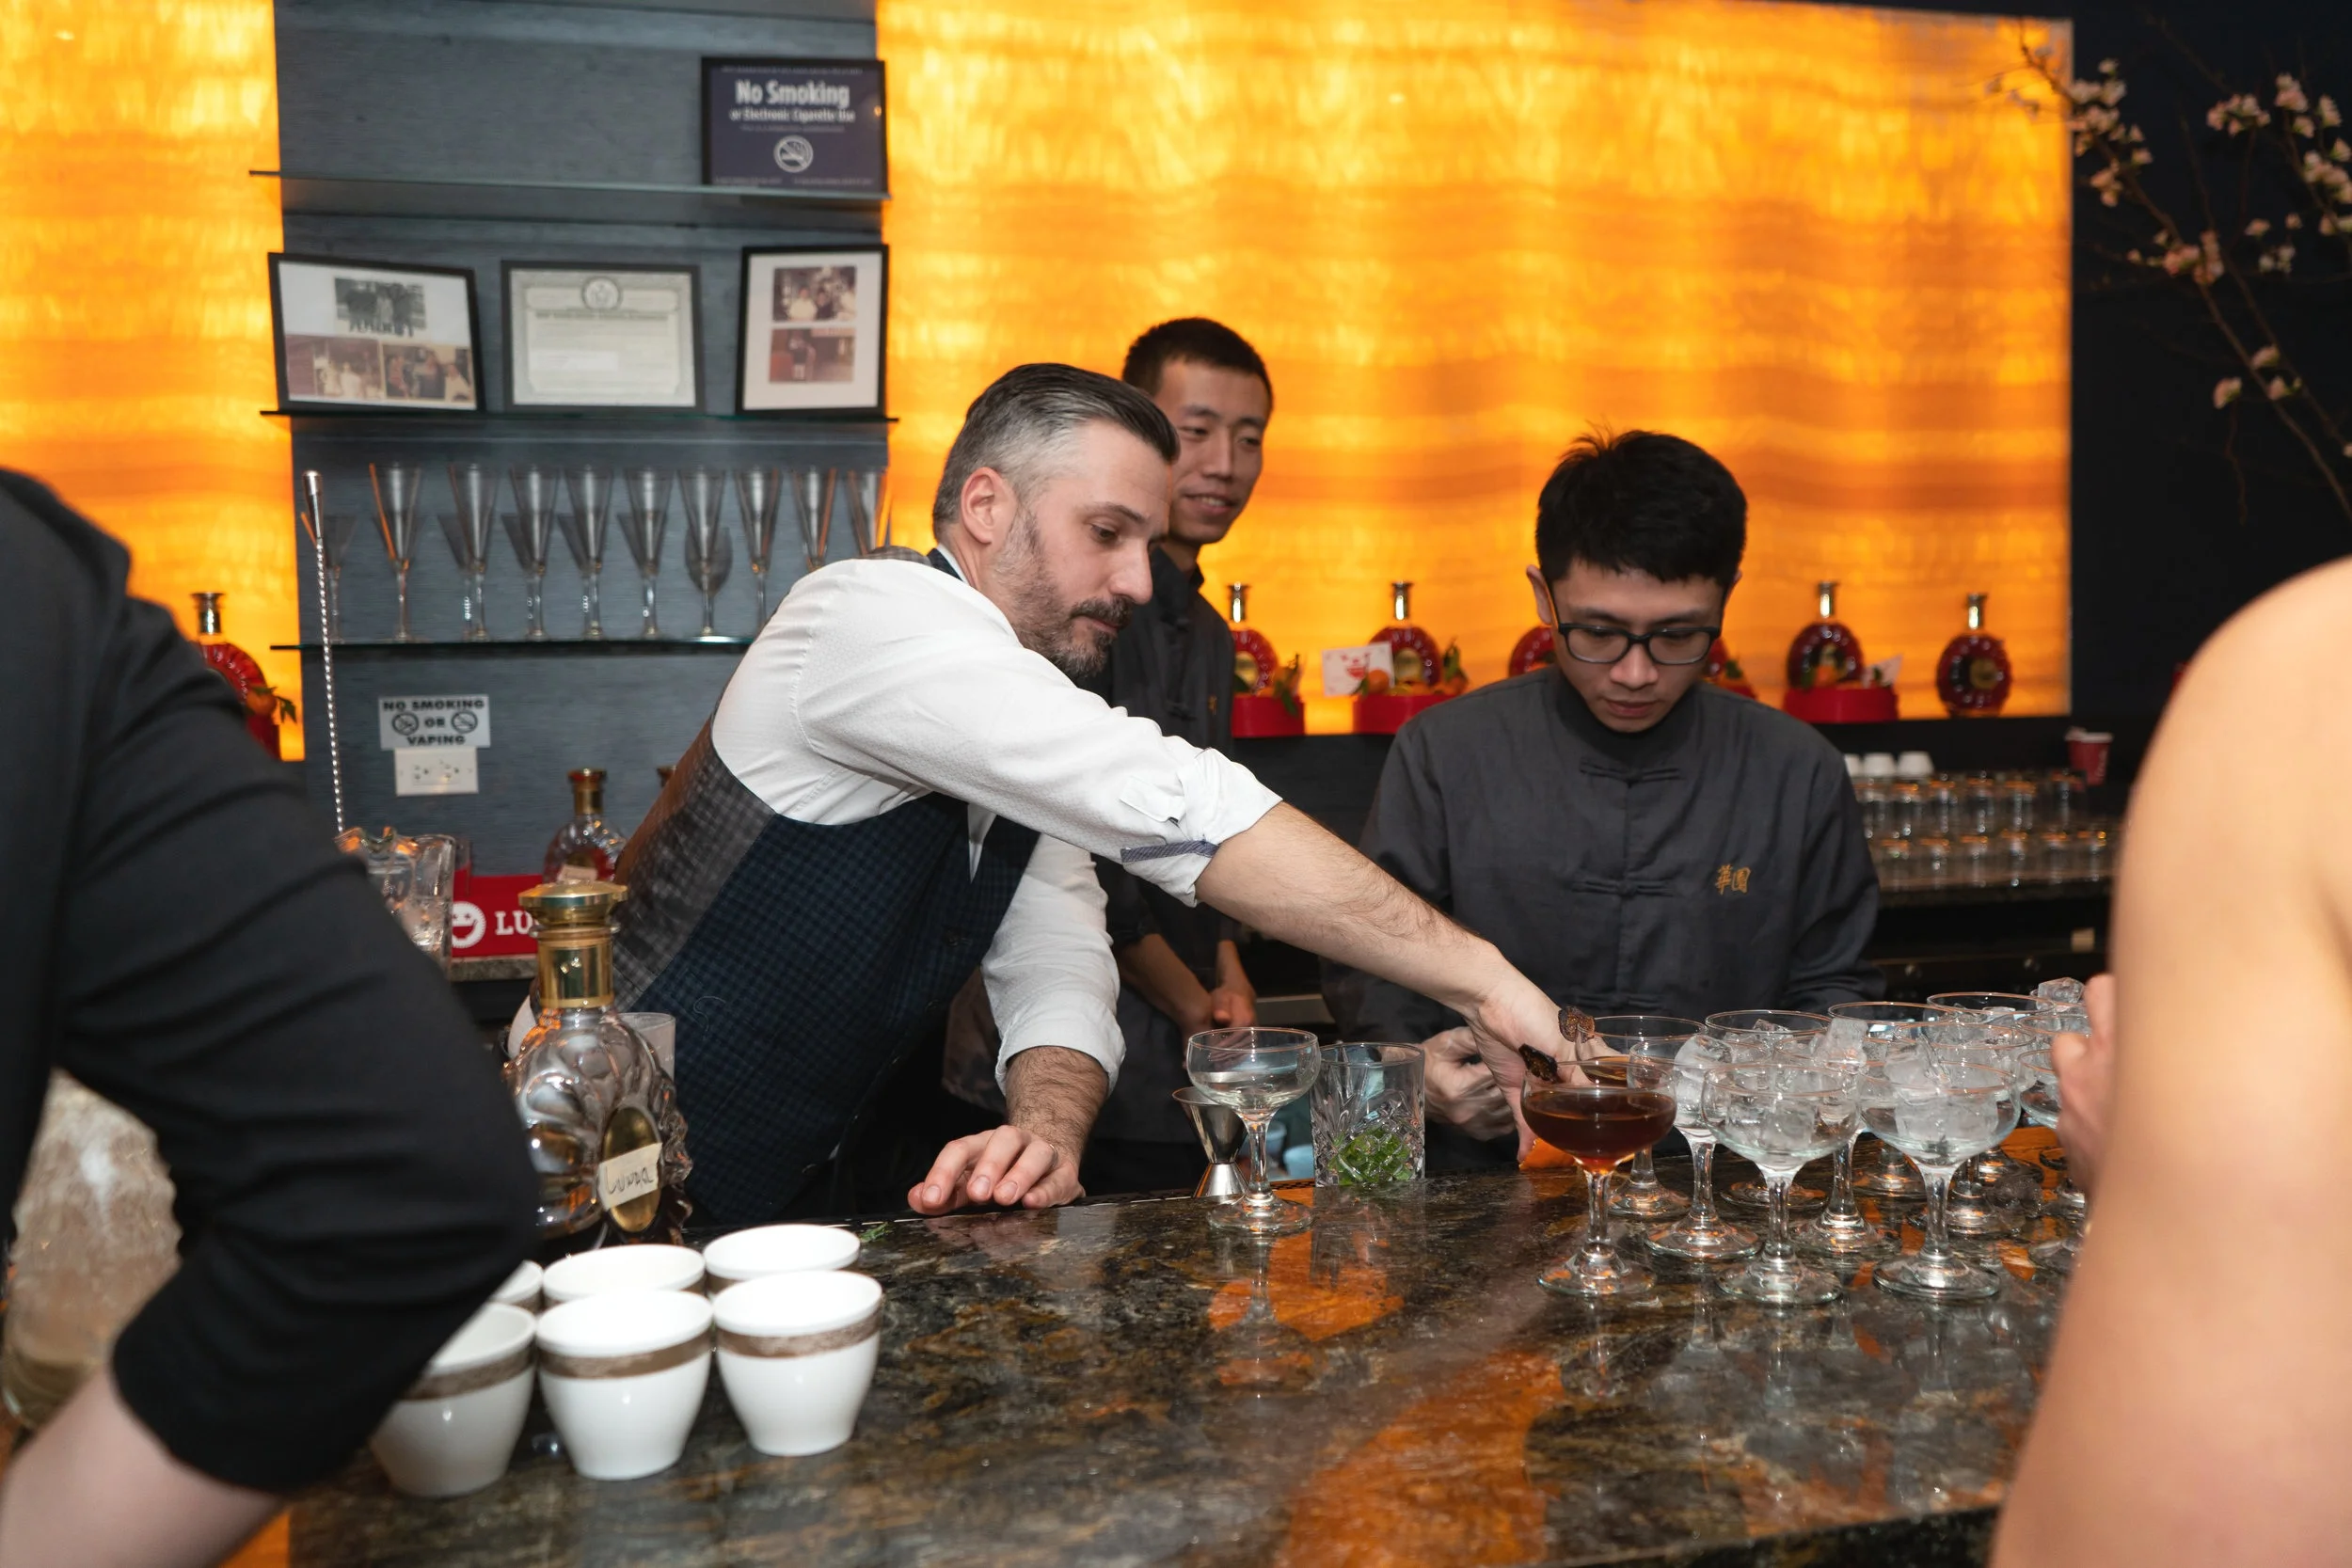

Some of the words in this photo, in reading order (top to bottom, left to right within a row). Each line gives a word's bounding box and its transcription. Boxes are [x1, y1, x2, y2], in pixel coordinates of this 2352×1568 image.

[735, 79, 763, 105] No
[766, 79, 850, 109] Smoking
[383, 701, 406, 711] NO
[412, 699, 485, 710] SMOKING
[424, 718, 446, 728] OR
[406, 736, 466, 746] VAPING
